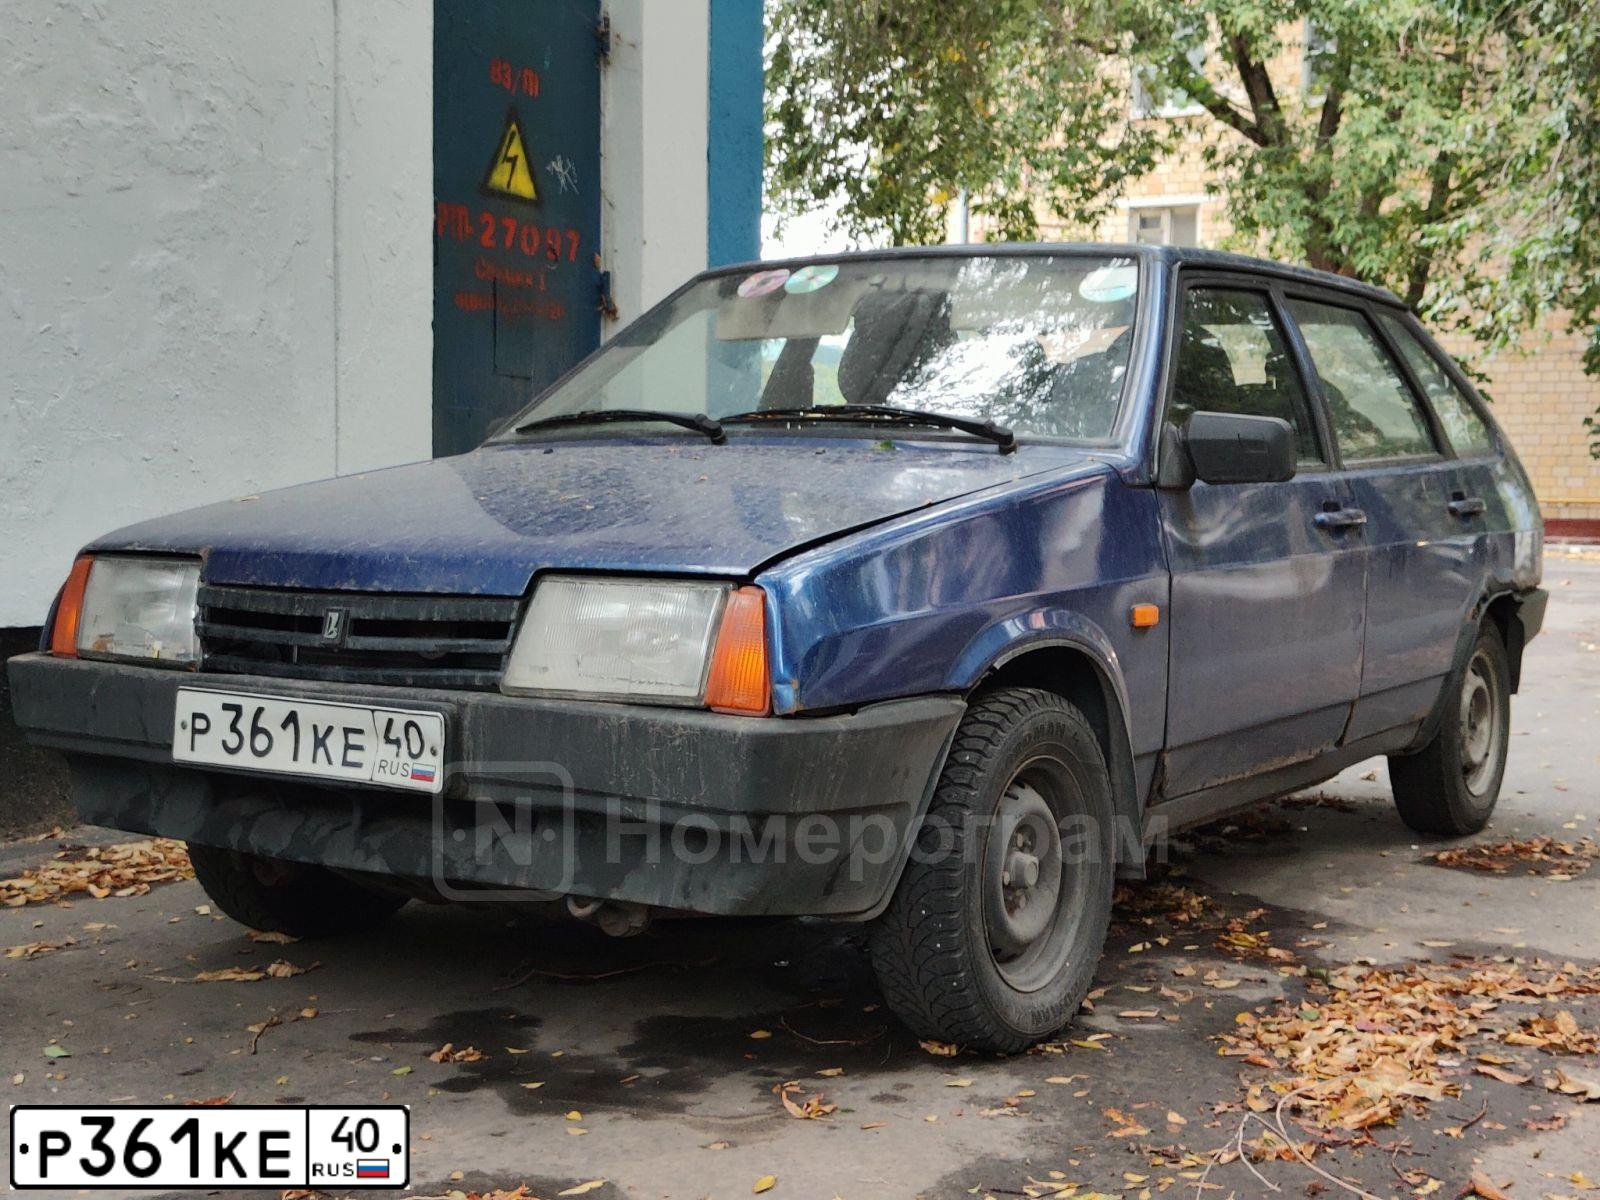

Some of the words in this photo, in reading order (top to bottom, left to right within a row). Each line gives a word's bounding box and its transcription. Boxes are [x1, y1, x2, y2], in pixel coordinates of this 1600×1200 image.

[479, 212, 581, 264] 27097
[190, 702, 365, 769] Р361КЕ
[383, 717, 425, 760] 40
[377, 758, 410, 778] RUS
